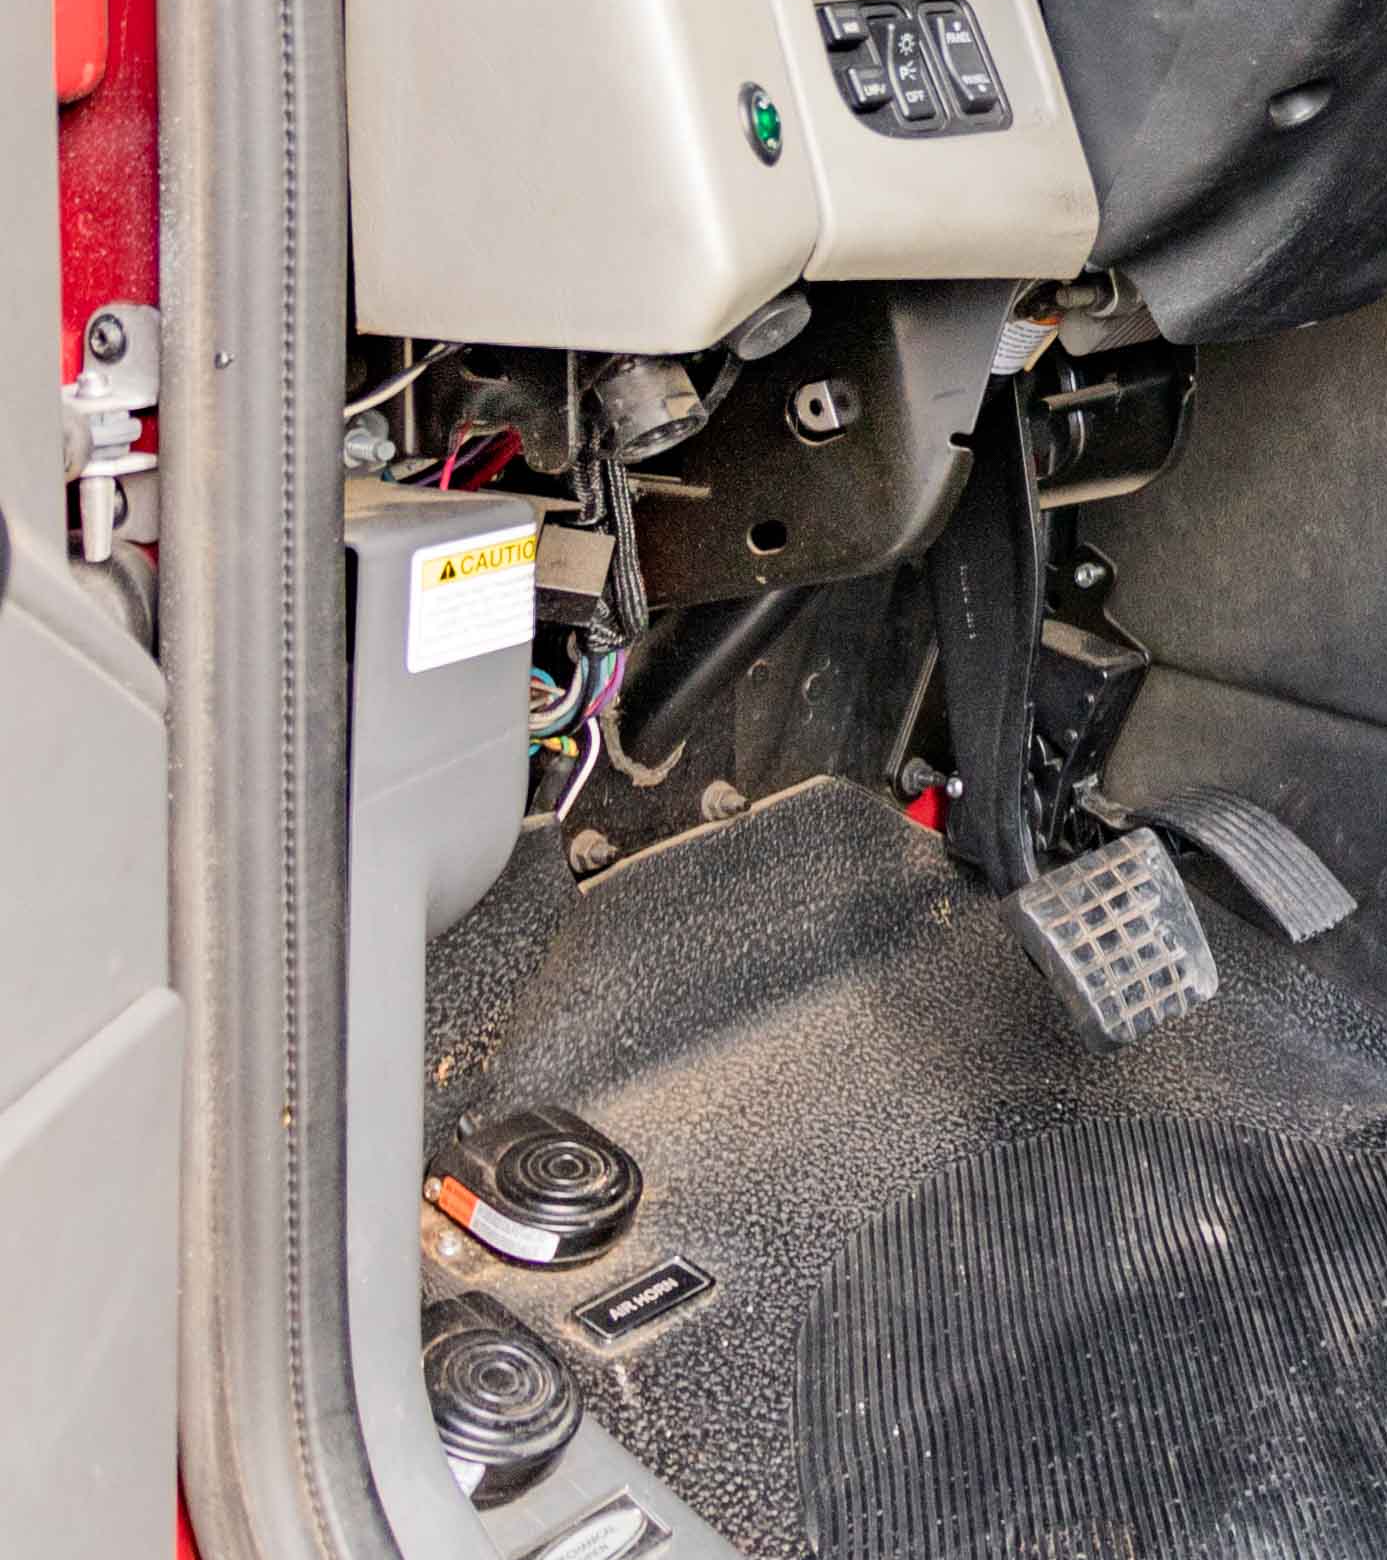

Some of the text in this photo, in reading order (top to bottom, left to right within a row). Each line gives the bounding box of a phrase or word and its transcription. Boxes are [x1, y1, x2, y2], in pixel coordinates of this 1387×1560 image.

[460, 539, 535, 575] CAUTIO
[608, 1276, 679, 1322] AIR HORN
